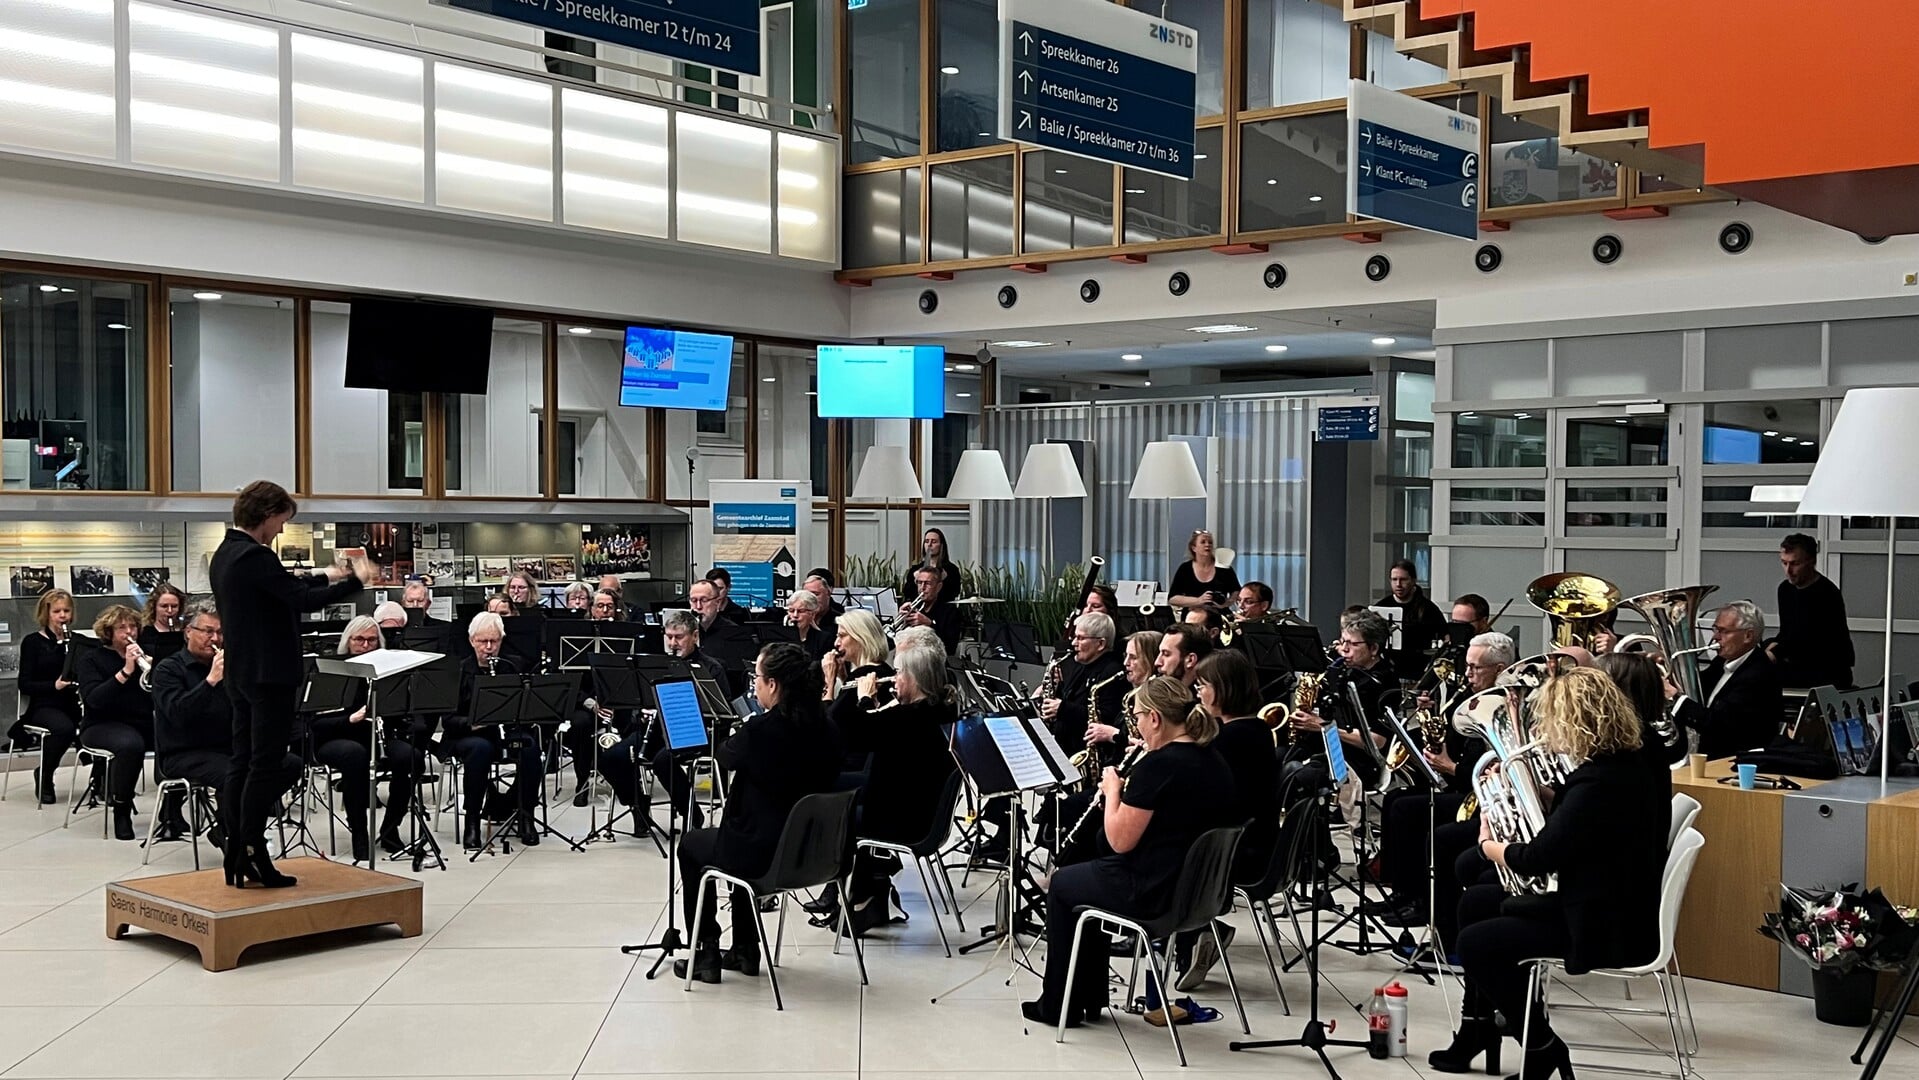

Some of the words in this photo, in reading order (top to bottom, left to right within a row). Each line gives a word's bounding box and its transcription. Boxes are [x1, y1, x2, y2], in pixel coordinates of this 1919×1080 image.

[555, 0, 660, 34] Spreekkamer
[663, 21, 678, 40] 12
[681, 26, 711, 48] t/m
[714, 33, 732, 52] 24
[1149, 23, 1193, 49] ZNSTD
[1041, 39, 1106, 70] Spreekkamer
[1107, 58, 1120, 74] 26
[1040, 79, 1106, 107] Artsenkamer
[1107, 97, 1119, 112] 25
[1040, 117, 1065, 137] Balie
[1067, 124, 1072, 138] /
[1073, 125, 1136, 153] Spreekkamer
[1137, 141, 1148, 155] 27
[1149, 144, 1167, 161] t/m
[1168, 147, 1180, 163] 36
[1447, 115, 1478, 135] ZNSTD
[1376, 133, 1393, 149] Balie
[1398, 139, 1440, 162] Spreekkamer
[1375, 164, 1394, 181] Klant
[1394, 170, 1428, 189] PC-ruimte
[110, 892, 136, 914] Saens
[139, 901, 178, 927] Harmonie
[181, 912, 209, 936] Orkest
